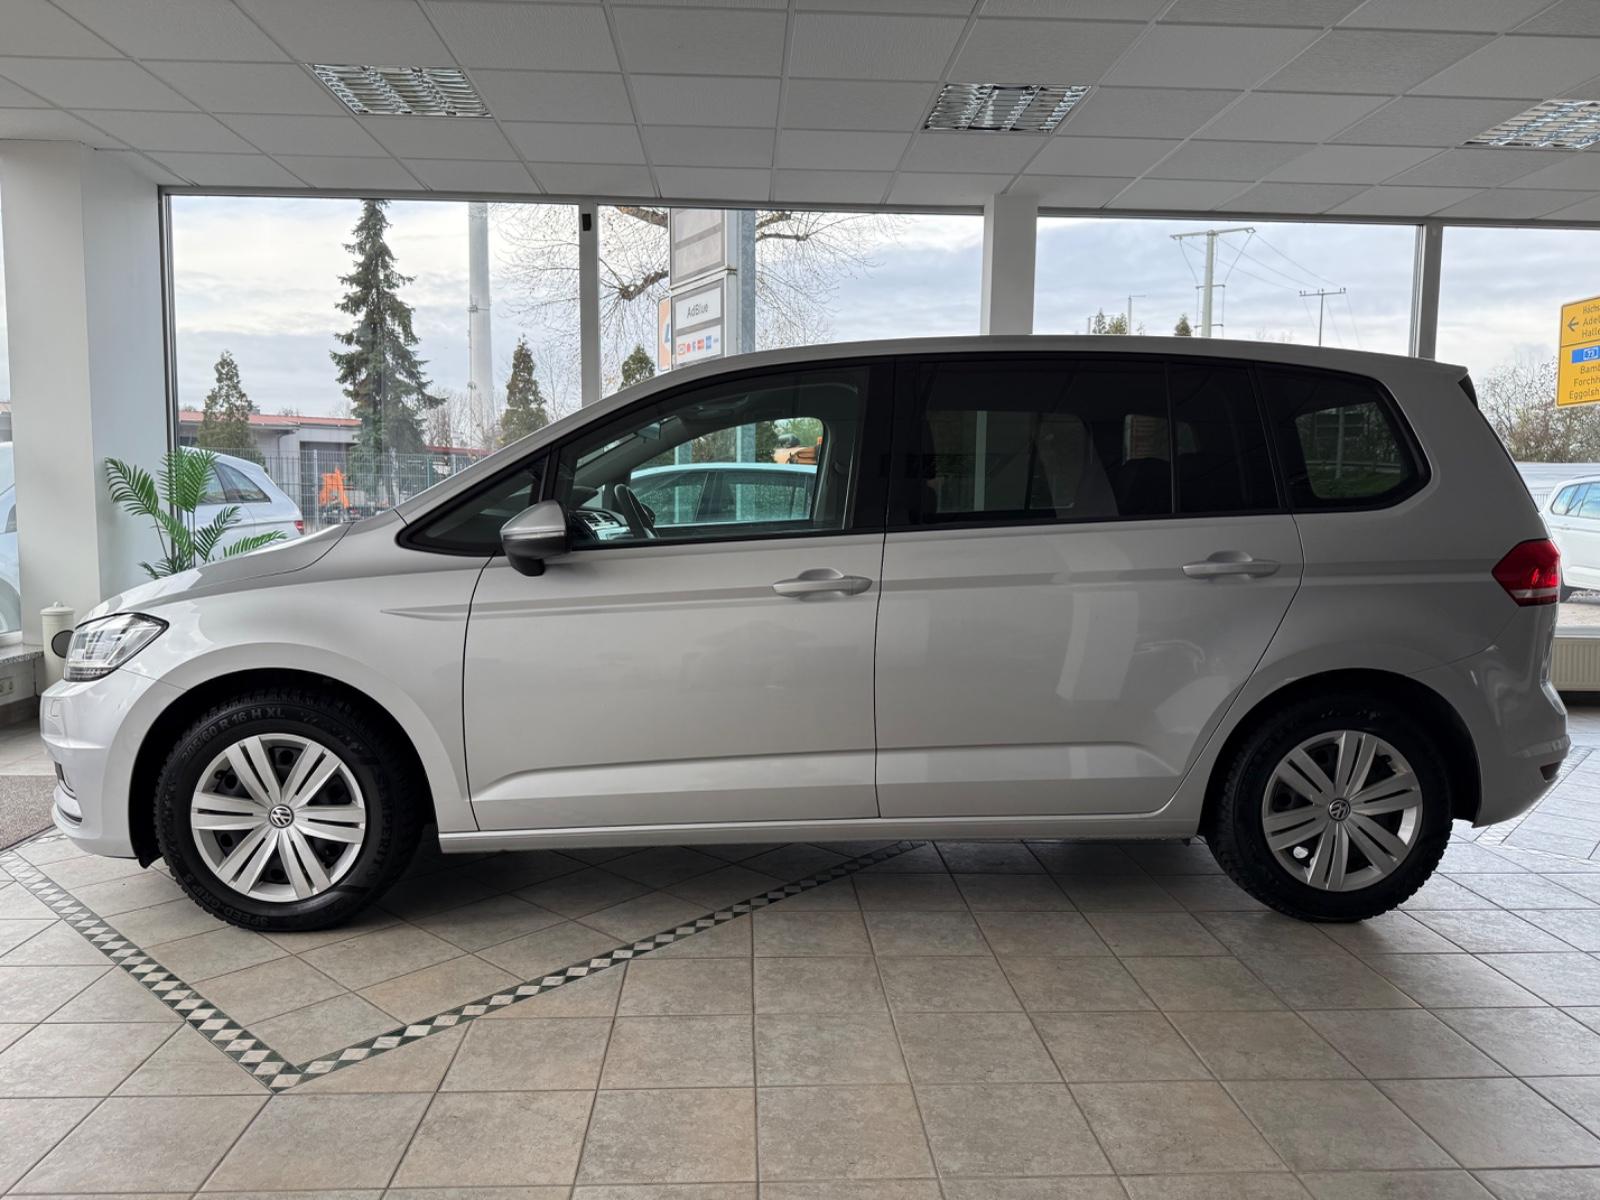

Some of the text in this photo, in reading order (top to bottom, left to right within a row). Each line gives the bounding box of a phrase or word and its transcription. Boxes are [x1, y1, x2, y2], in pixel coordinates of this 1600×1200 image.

[687, 304, 708, 318] AdBlue
[218, 718, 231, 730] R
[231, 711, 247, 724] 16
[251, 707, 264, 719] H
[265, 707, 286, 719] XL
